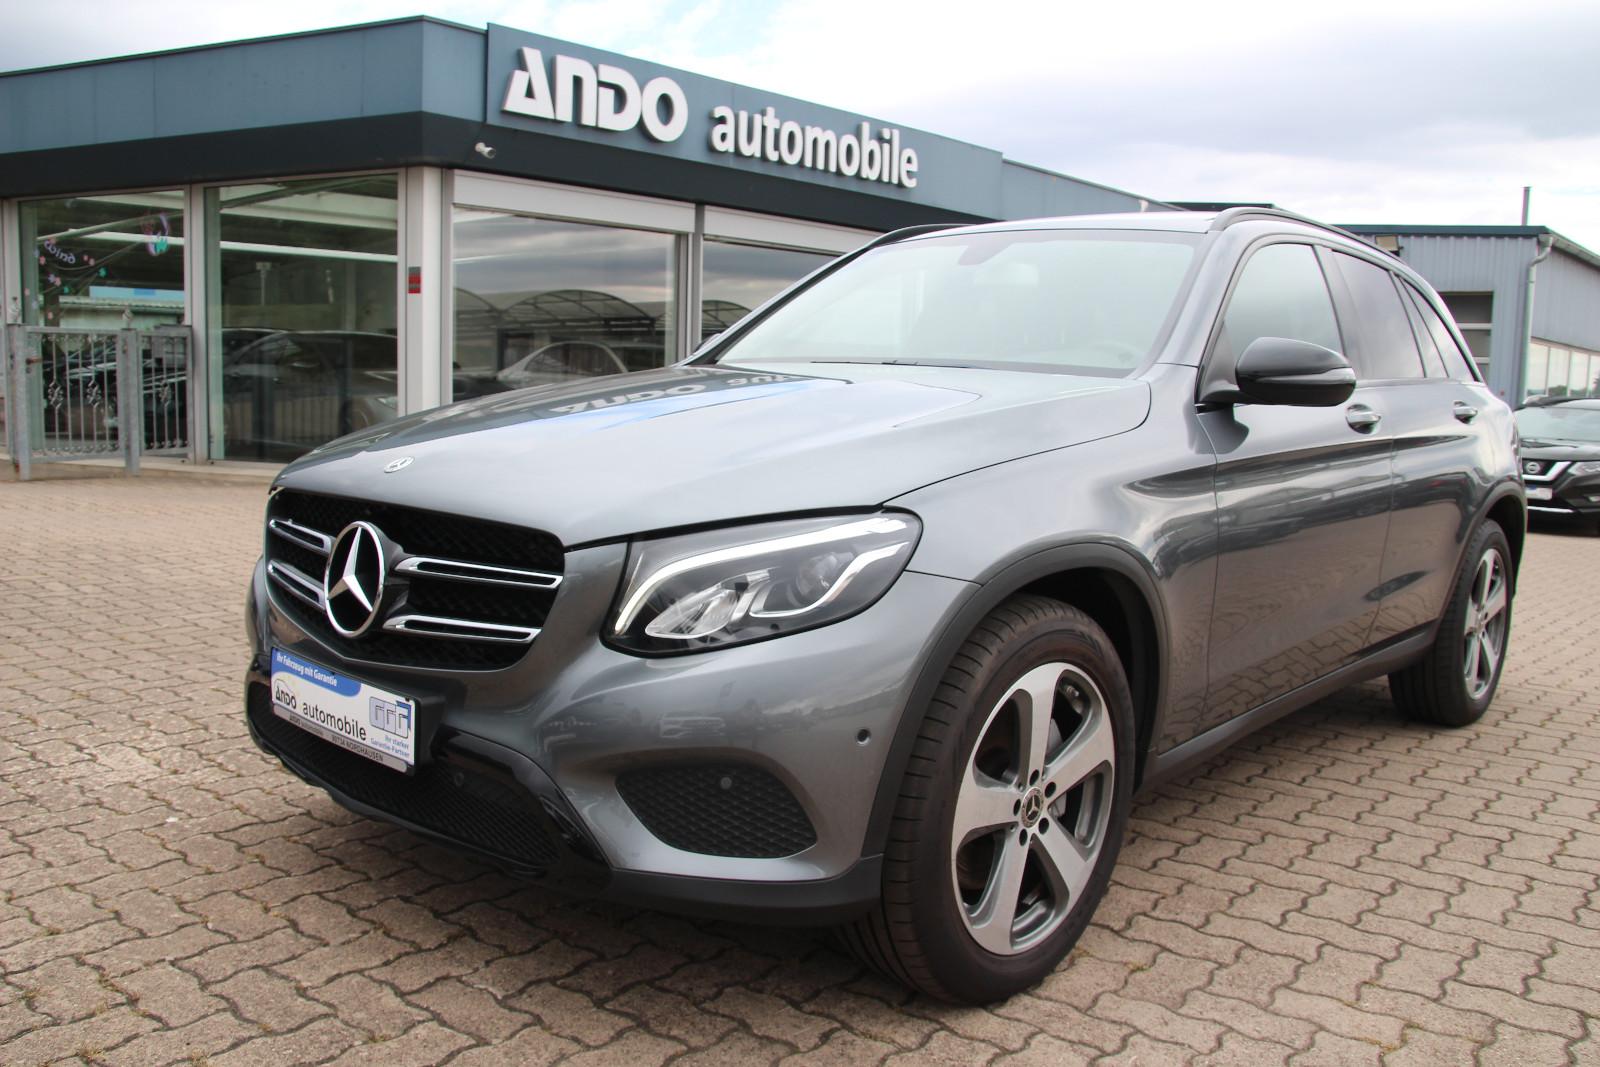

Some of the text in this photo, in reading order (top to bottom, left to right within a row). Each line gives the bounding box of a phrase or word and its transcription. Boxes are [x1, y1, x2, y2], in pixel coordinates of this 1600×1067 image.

[501, 46, 918, 188] ANDO automobile
[305, 666, 313, 677] mit
[314, 669, 337, 686] Garantie
[275, 686, 296, 709] ANDO
[302, 702, 366, 741] automobile
